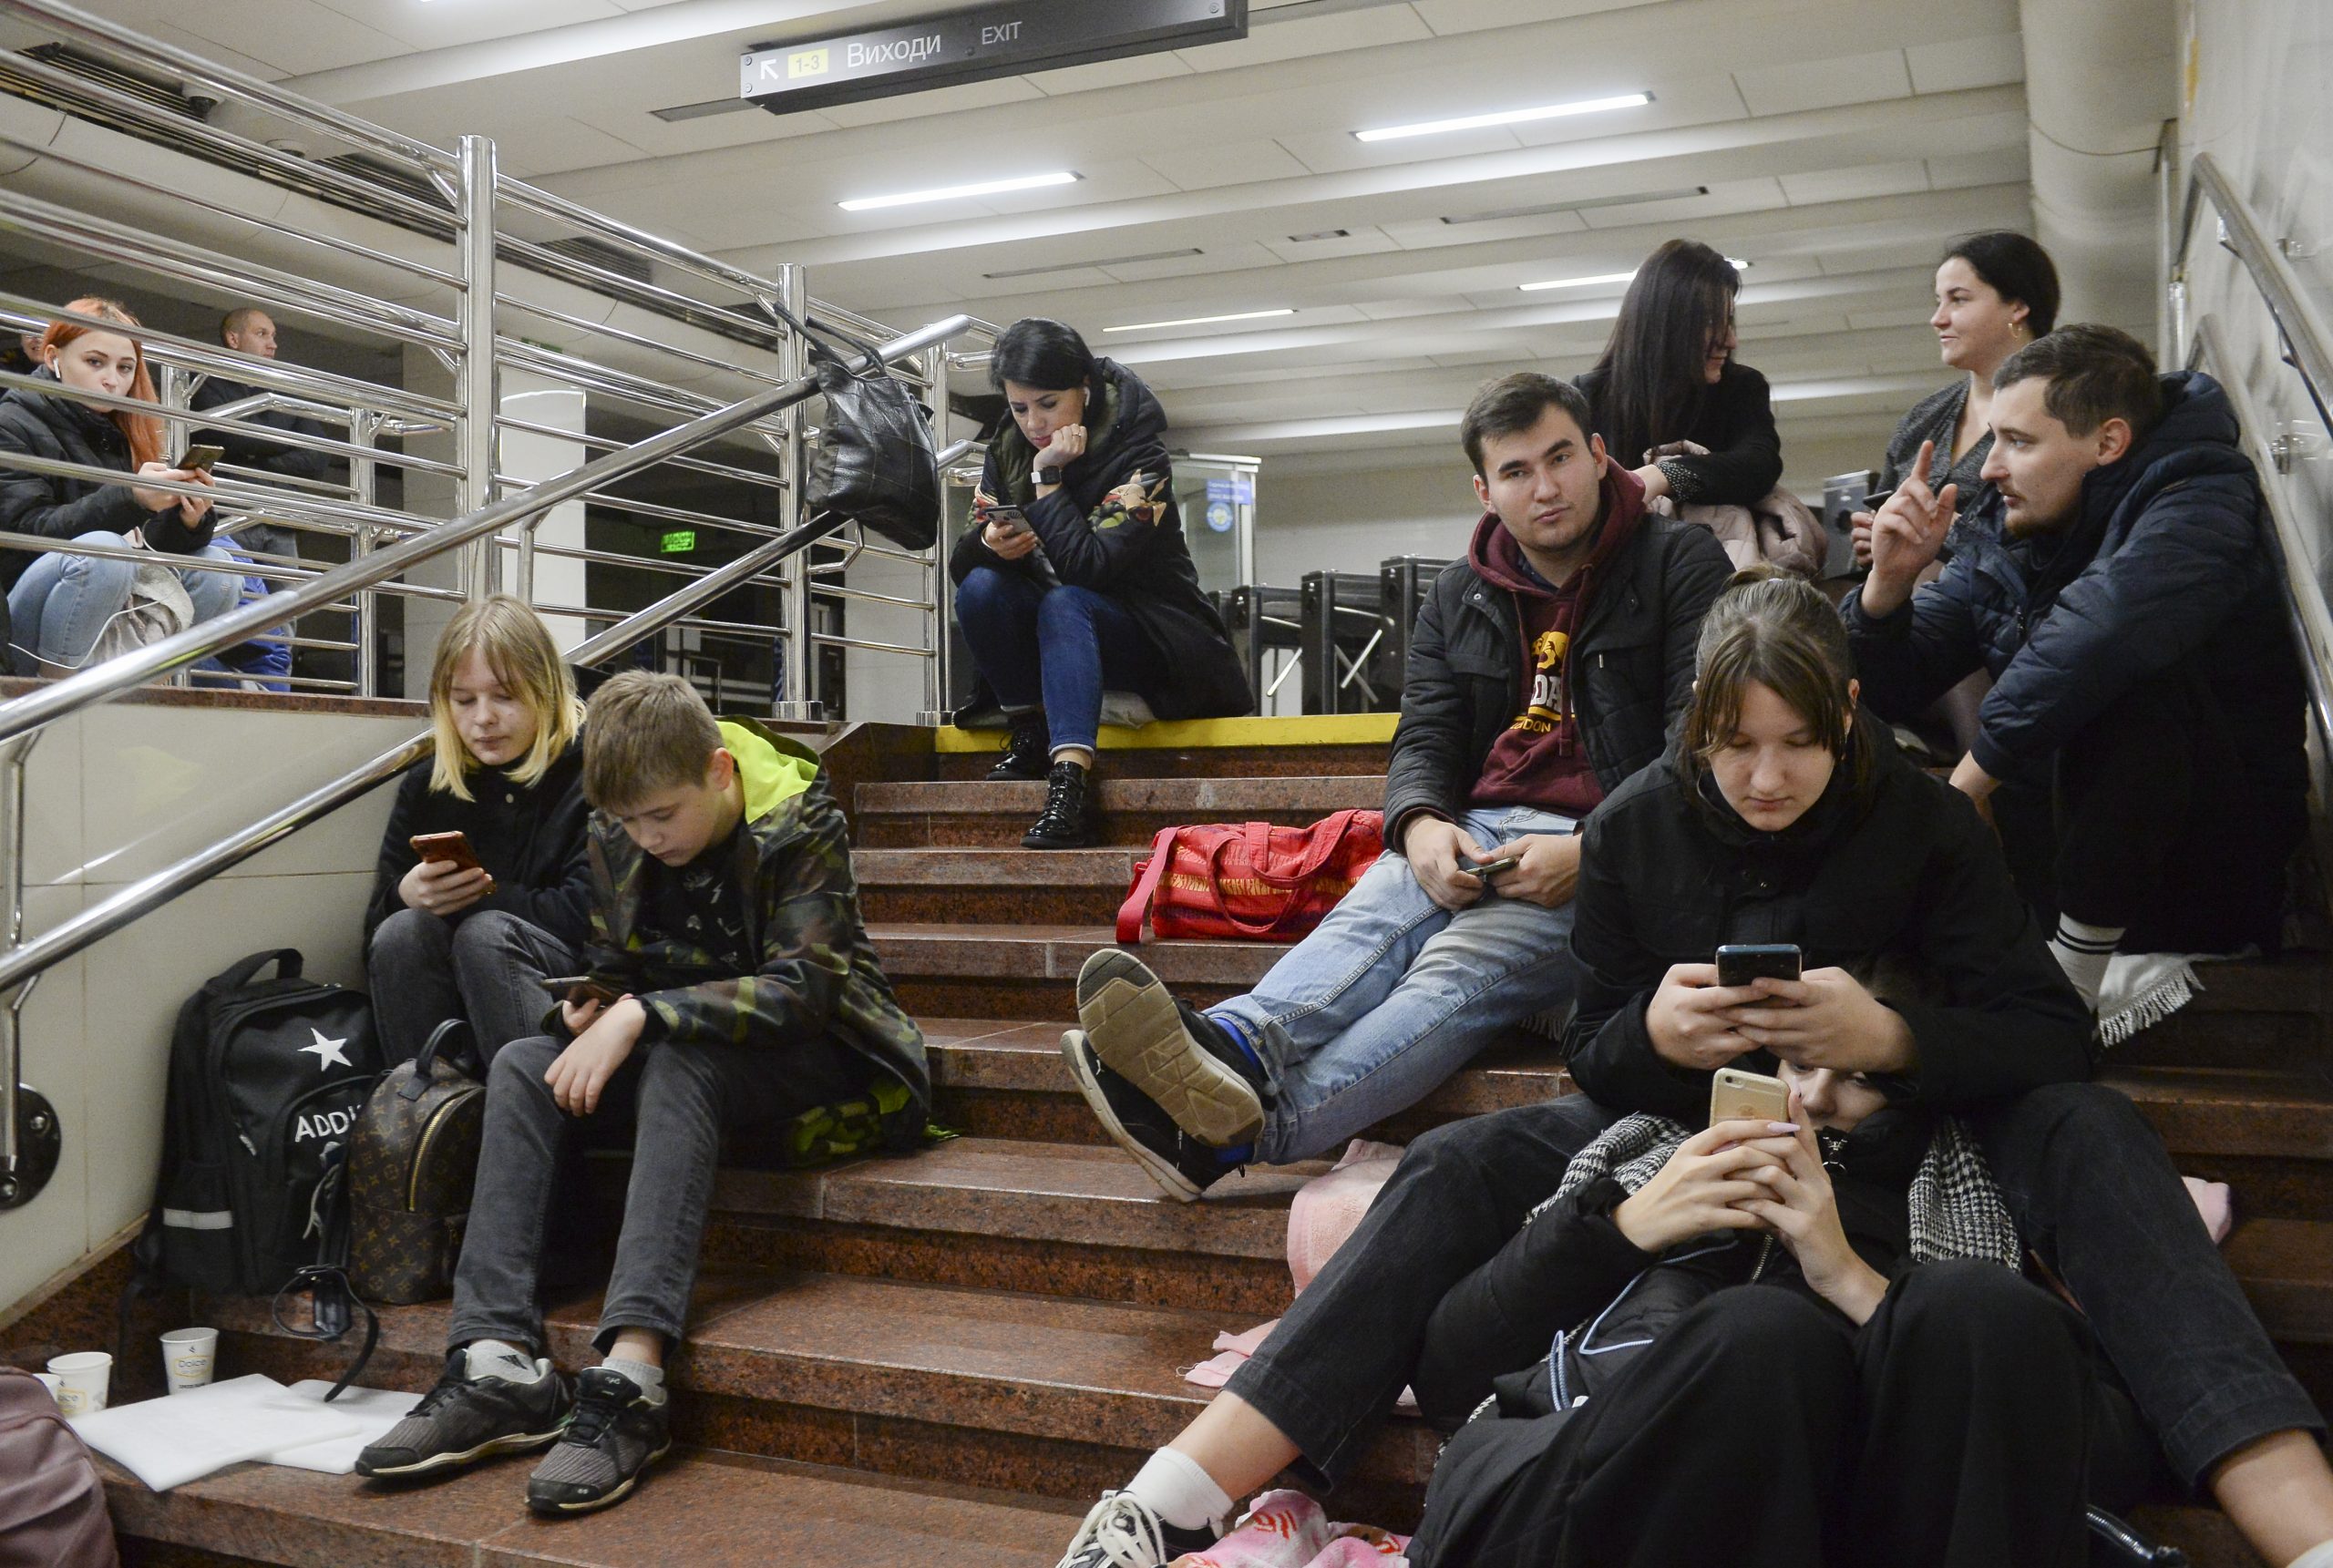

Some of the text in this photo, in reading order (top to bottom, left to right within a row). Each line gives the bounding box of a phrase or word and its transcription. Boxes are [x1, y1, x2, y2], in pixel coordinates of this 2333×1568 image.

[981, 21, 1023, 45] EXIT
[796, 35, 941, 73] 1-3 Виходи
